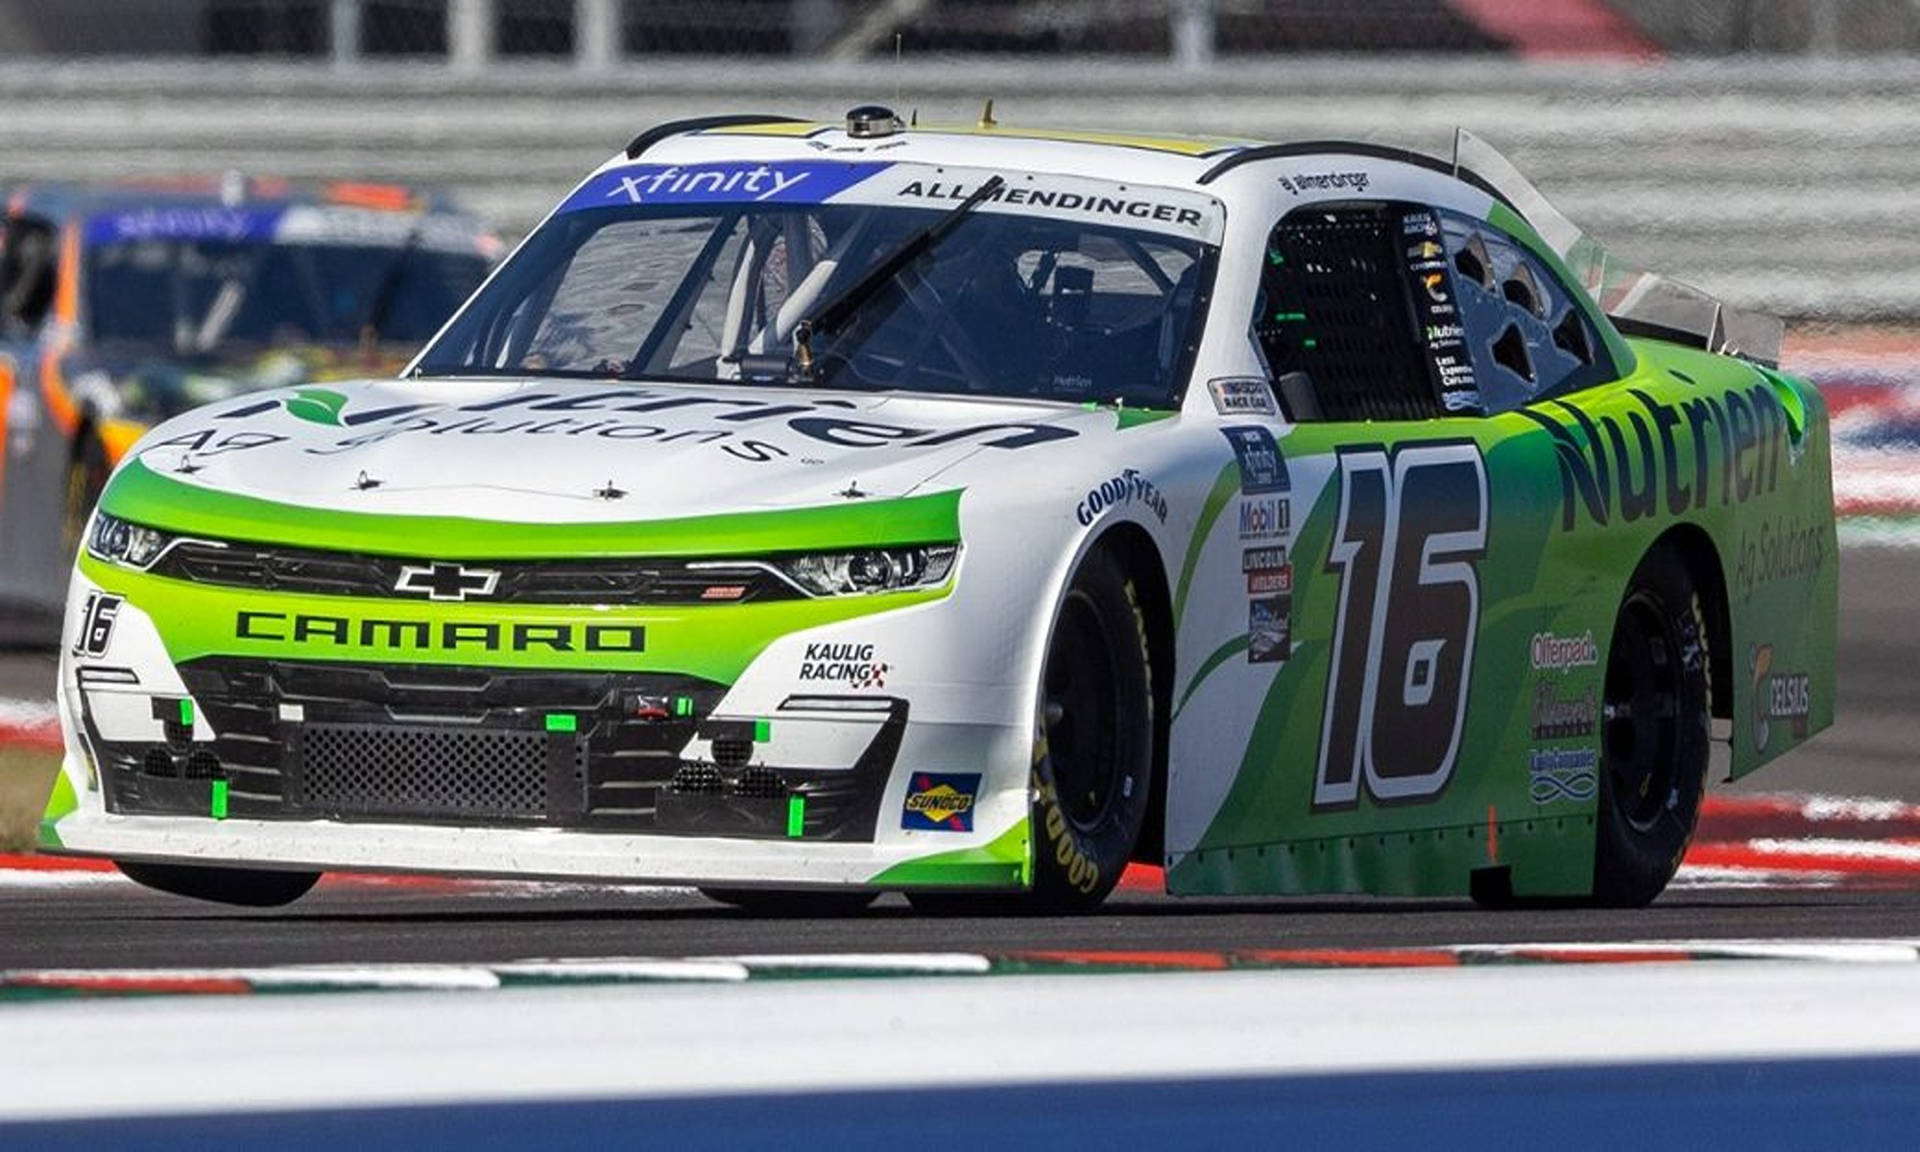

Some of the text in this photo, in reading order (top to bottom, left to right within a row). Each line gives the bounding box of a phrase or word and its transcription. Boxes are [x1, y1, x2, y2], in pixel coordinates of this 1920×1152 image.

[606, 166, 811, 203] xfinity
[141, 429, 290, 457] Ag
[1511, 369, 1780, 532] Nutrien
[1077, 468, 1168, 528] GOODYEAR
[1240, 500, 1275, 532] Mobil
[72, 589, 127, 659] 16
[236, 611, 646, 653] CAMARO
[1310, 437, 1491, 811] 16
[804, 643, 875, 662] KAULIG
[800, 663, 871, 681] RACING
[1770, 677, 1809, 717] CELSIUS
[908, 794, 970, 811] SUNOCO
